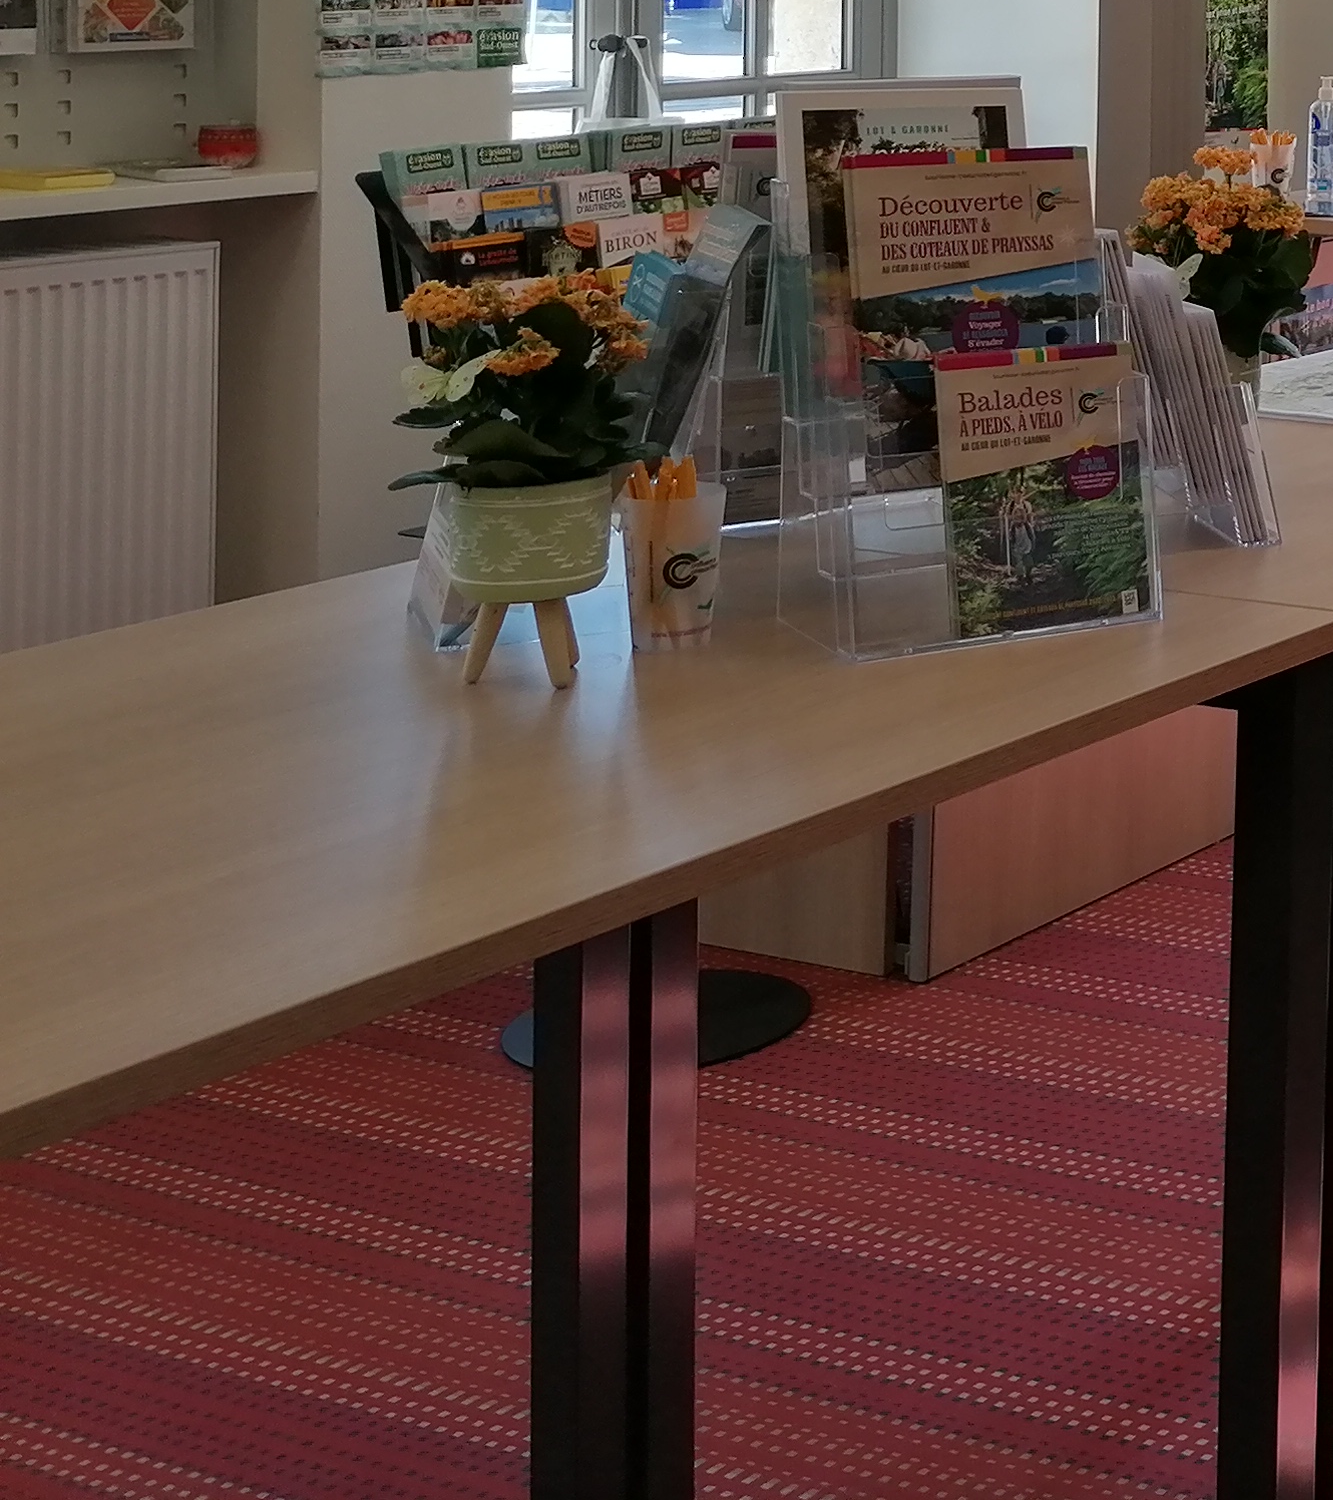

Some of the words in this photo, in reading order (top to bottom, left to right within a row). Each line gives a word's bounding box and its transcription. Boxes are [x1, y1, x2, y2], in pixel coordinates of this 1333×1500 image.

[866, 126, 885, 137] LOT
[901, 124, 950, 135] GARONNE
[578, 186, 623, 204] MÉTIERS
[576, 200, 626, 215] D'AUTREFOIS
[878, 193, 1023, 218] Découverte
[880, 222, 899, 239] DU
[903, 218, 978, 238] CONFLUENT
[982, 219, 990, 233] &
[605, 231, 658, 253] BIRON
[881, 244, 907, 261] DES
[910, 239, 970, 260] COTEAUX
[973, 238, 989, 255] DE
[992, 235, 1054, 254] PRAYSSAS
[968, 320, 1002, 331] Voyager
[968, 338, 1005, 348] S'évader
[958, 386, 1063, 414] Balades
[960, 415, 969, 438] À
[972, 414, 1016, 437] PIEDS,
[1018, 410, 1027, 432] À
[1030, 407, 1063, 430] VÉLO
[961, 443, 970, 451] AU
[1000, 434, 1051, 447] LOT-ET-GARONNE
